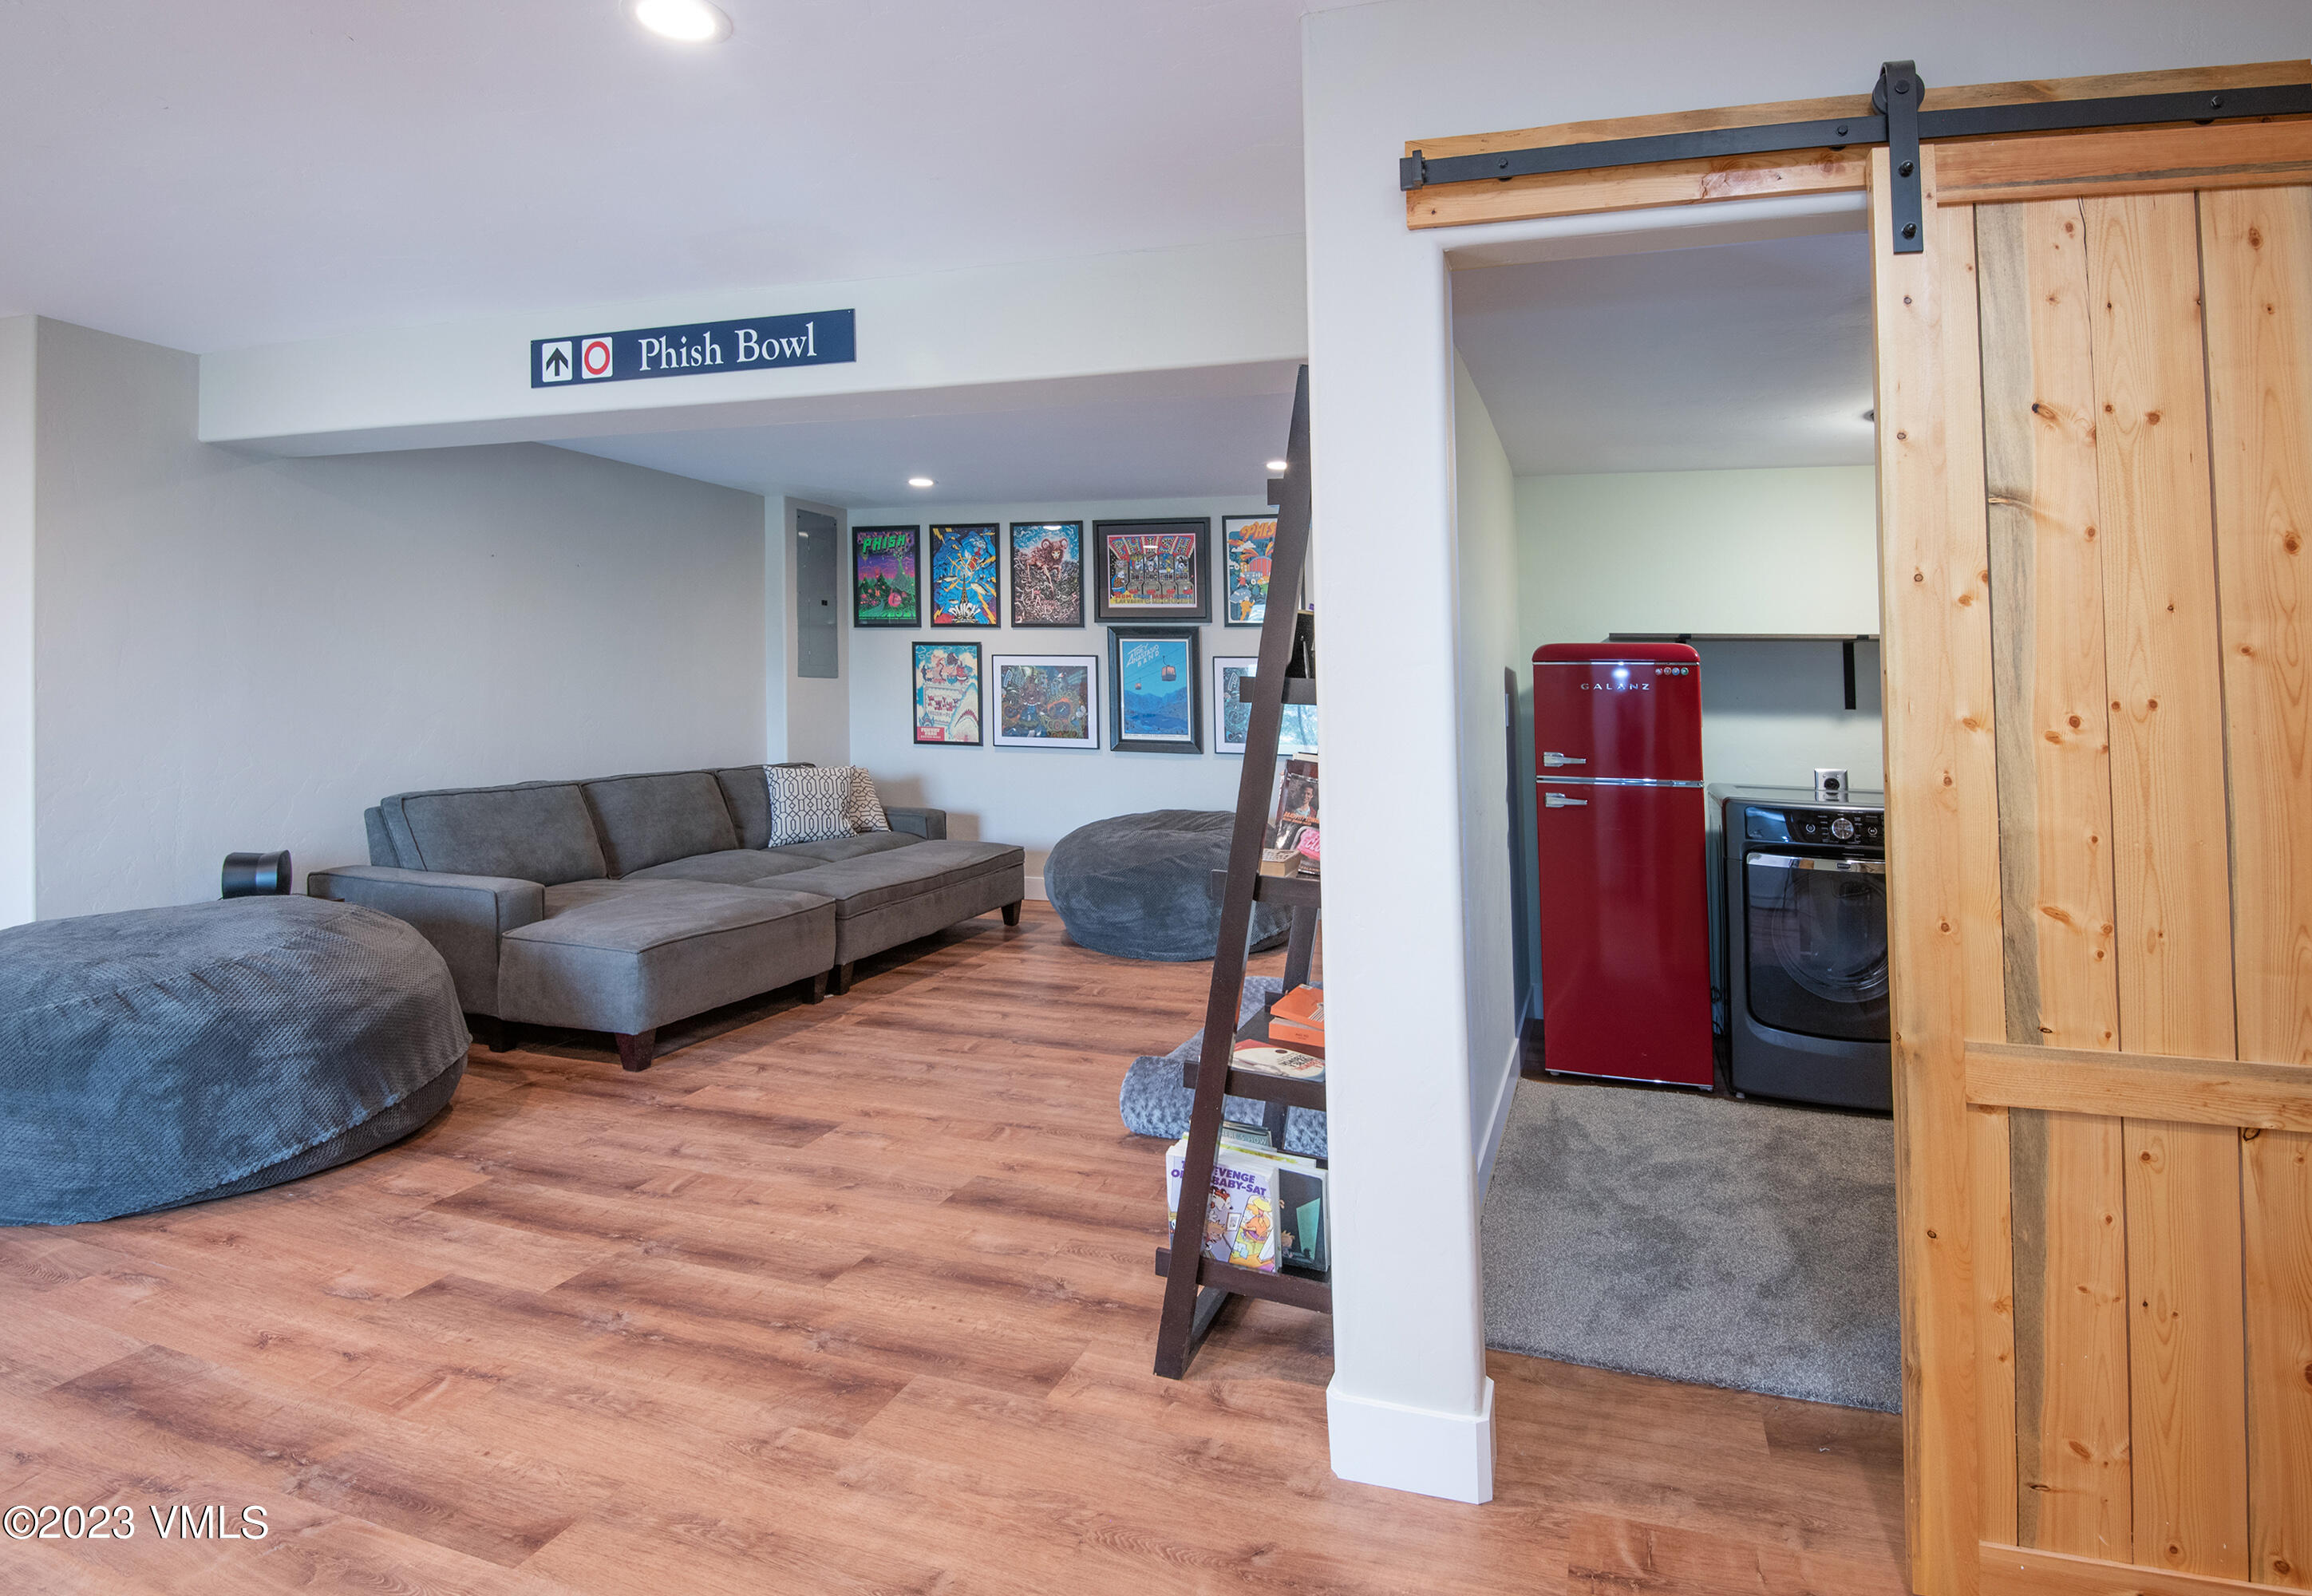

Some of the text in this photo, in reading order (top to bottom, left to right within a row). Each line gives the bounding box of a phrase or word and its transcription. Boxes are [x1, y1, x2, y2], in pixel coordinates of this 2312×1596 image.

[638, 321, 817, 372] Phish Bowl
[1239, 521, 1277, 542] PHIS
[863, 534, 906, 554] PHISH
[1112, 535, 1192, 556] PHISH
[1214, 1167, 1255, 1183] EVENGE
[1212, 1176, 1267, 1195] BABY-SAT
